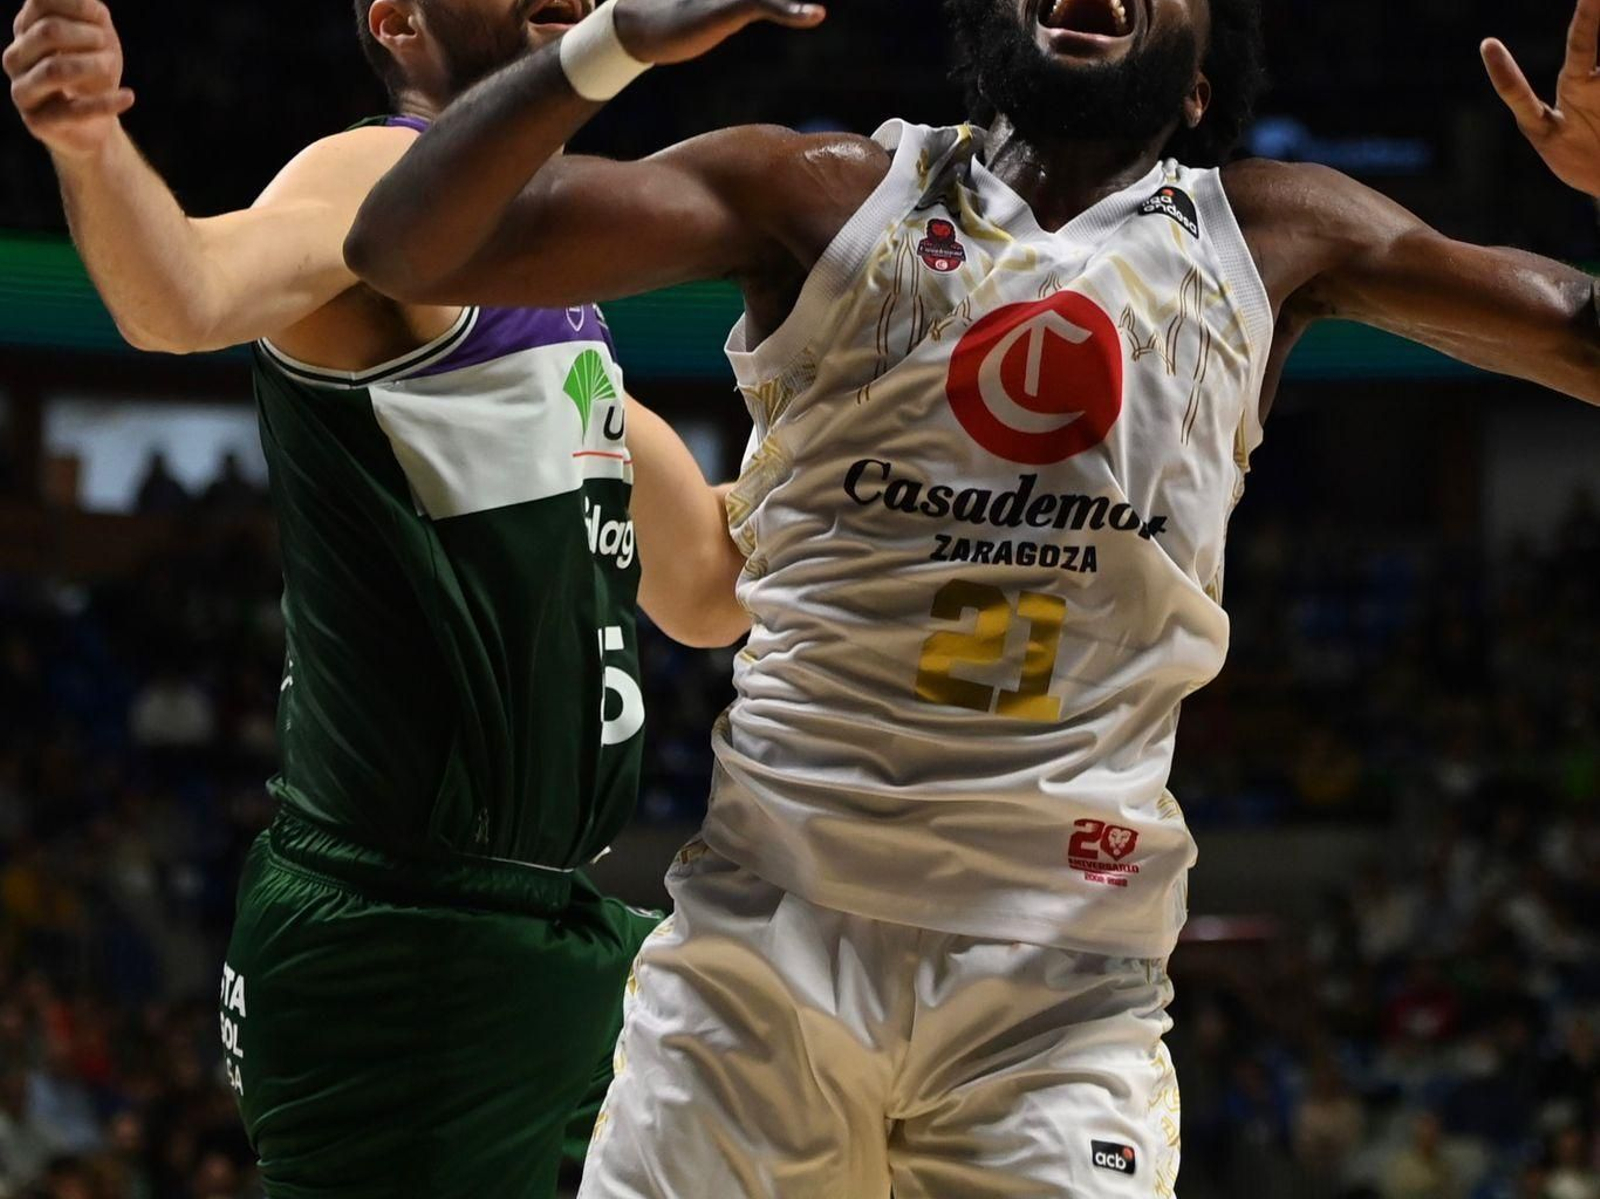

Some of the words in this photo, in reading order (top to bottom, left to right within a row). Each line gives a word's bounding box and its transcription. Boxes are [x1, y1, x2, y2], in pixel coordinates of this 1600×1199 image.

[843, 458, 1168, 540] Casademo
[930, 534, 1098, 573] ZARAGOZA
[916, 577, 1068, 723] 21
[1095, 1151, 1127, 1170] acb
